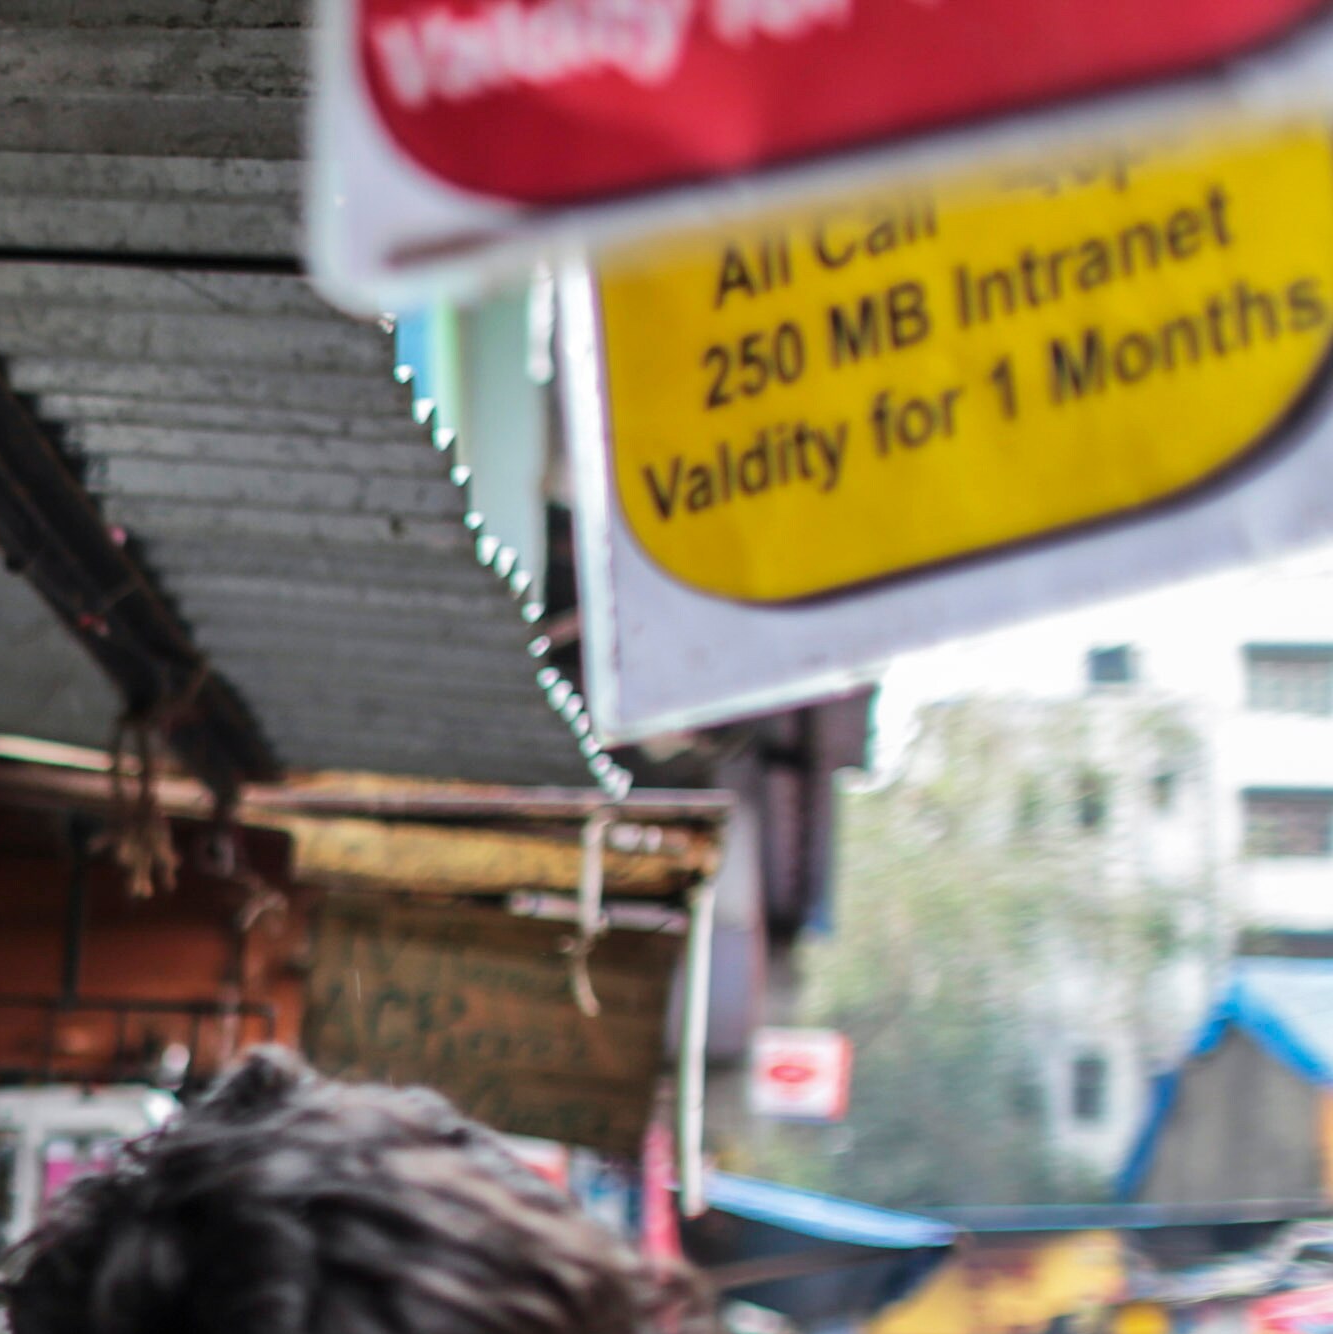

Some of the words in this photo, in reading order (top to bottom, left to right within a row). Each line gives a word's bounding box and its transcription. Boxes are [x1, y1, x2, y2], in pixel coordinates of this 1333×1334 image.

[642, 421, 848, 521] Valdity
[869, 388, 963, 457] for
[990, 355, 1017, 421] 1
[1049, 277, 1326, 407] Months
[703, 321, 804, 410] 250
[828, 281, 930, 369] MB
[953, 184, 1234, 330] Intranet
